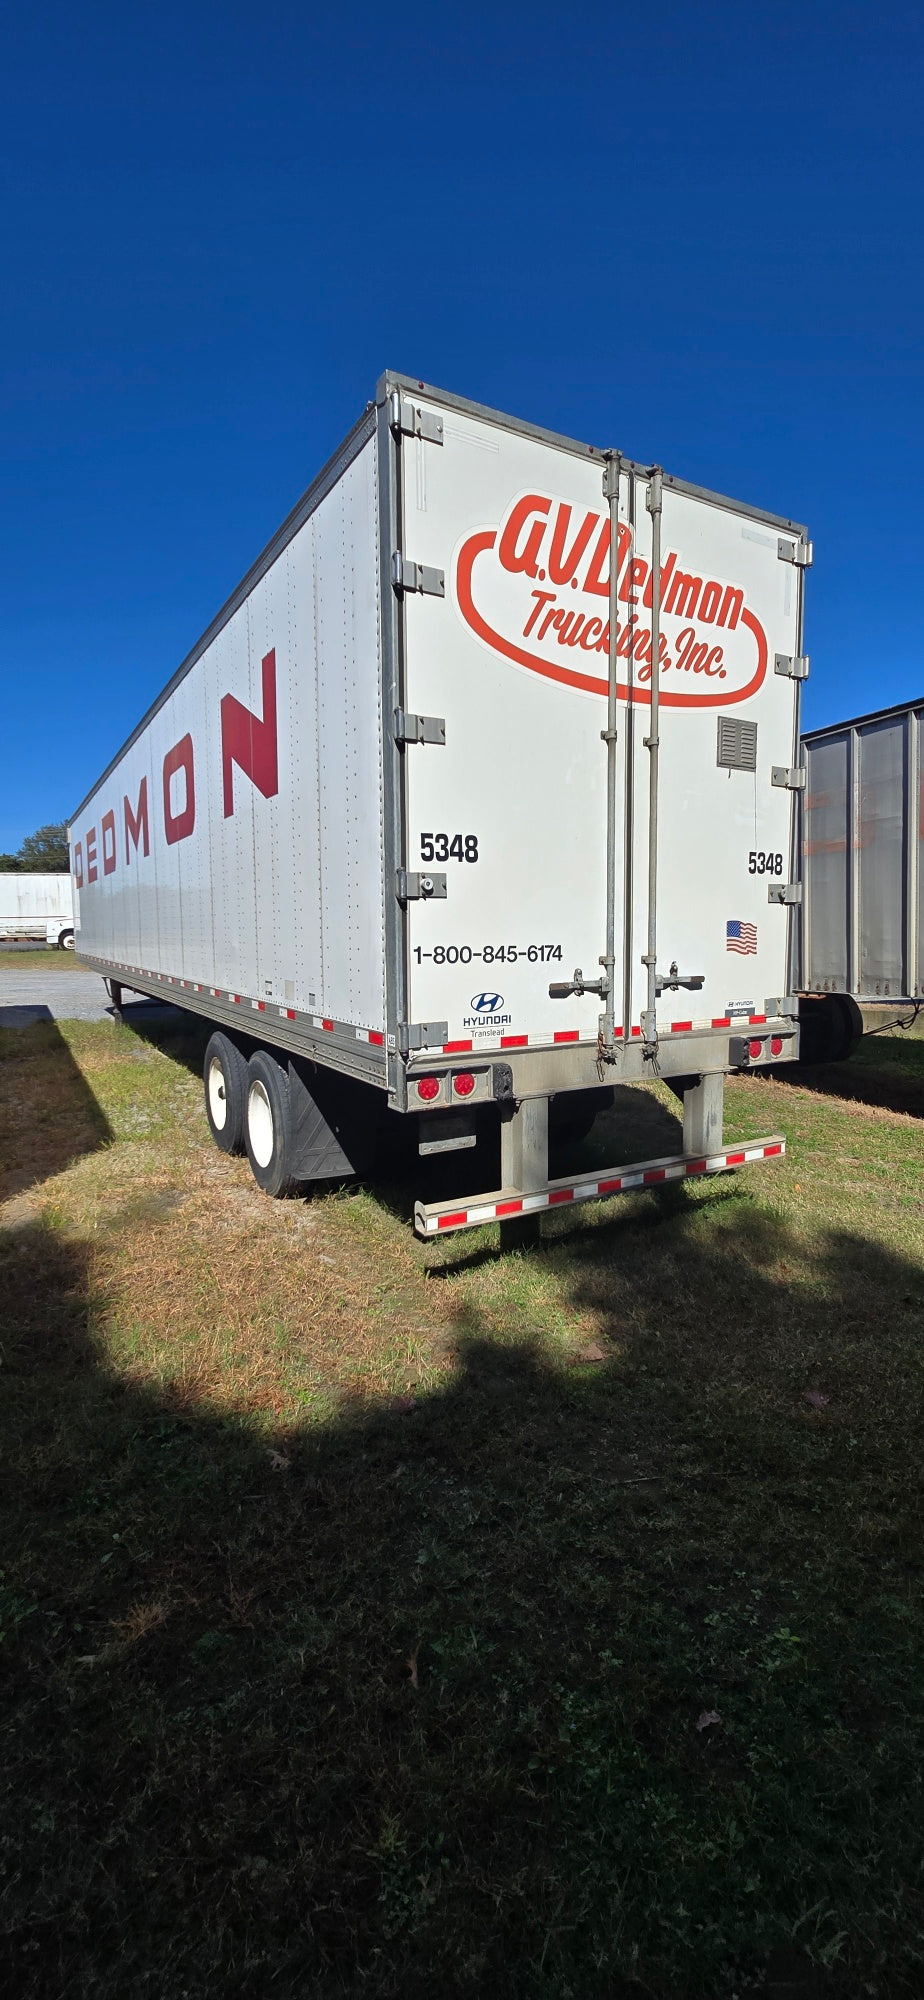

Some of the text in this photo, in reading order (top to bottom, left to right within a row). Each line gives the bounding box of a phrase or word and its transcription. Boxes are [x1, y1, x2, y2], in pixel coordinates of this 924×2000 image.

[675, 627, 727, 679] Inc.
[74, 647, 279, 889] DEDMON
[420, 832, 479, 863] 5348
[748, 851, 783, 876] 5348
[413, 944, 563, 964] 1-800-845-6174
[463, 1014, 512, 1027] HYUNDAI
[470, 1027, 505, 1038] Translead
